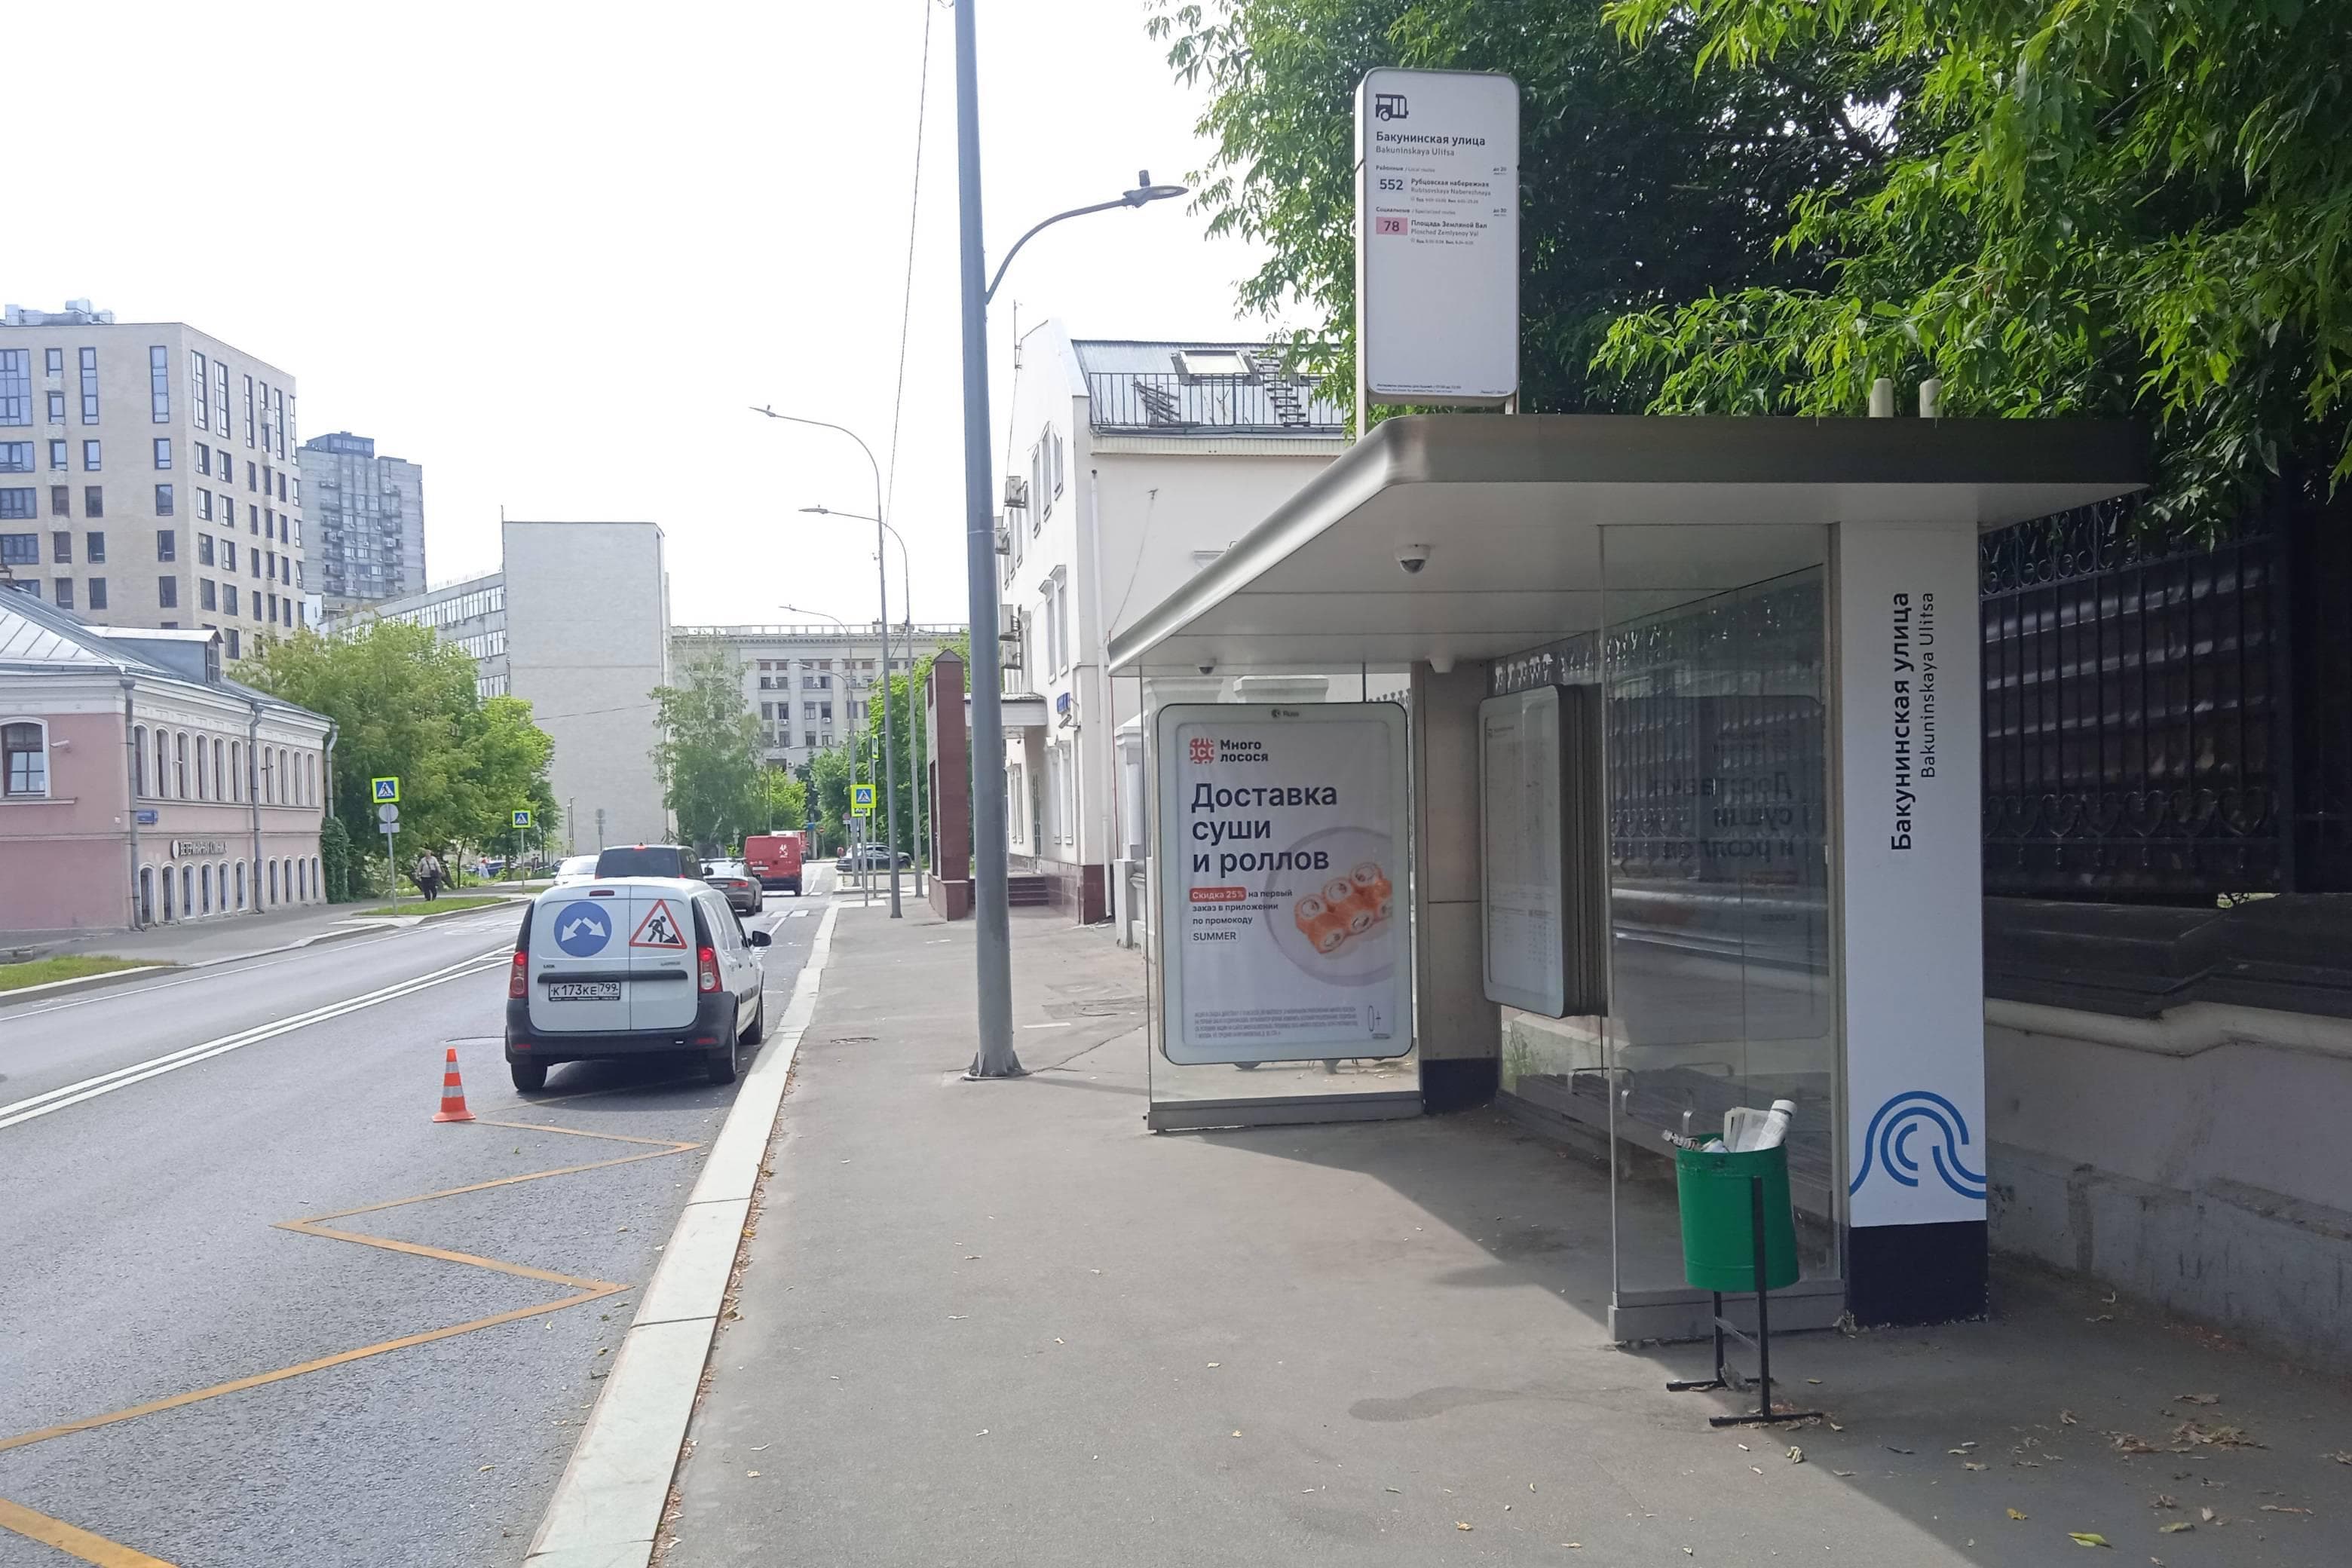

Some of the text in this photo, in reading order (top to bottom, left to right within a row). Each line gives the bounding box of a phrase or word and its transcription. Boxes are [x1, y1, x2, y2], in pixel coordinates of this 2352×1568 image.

[1376, 131, 1485, 147] Бакунинская улица
[1376, 145, 1455, 156] Bakuninskaya Ulitsa
[1380, 179, 1404, 190] 552
[1411, 178, 1449, 187] Рубцовская
[1383, 220, 1400, 231] 78
[1411, 219, 1441, 228] Площадь
[1442, 220, 1474, 228] Земляной
[1919, 593, 1937, 778] Bakuninskaya Ulitsa
[1891, 593, 1916, 850] Бакунинская улица
[1220, 739, 1262, 750] Много
[1220, 753, 1269, 762] лосося
[1191, 782, 1337, 813] Доставка
[1192, 820, 1271, 847] суши
[1193, 851, 1330, 879] и роллов
[1192, 891, 1225, 900] Скидка
[1226, 890, 1245, 899] 25%
[1260, 889, 1293, 899] первый
[1225, 903, 1279, 913] приложении
[1205, 917, 1253, 926] промокоду
[1193, 932, 1237, 942] SUMMER
[553, 983, 617, 996] К173КЕ 799
